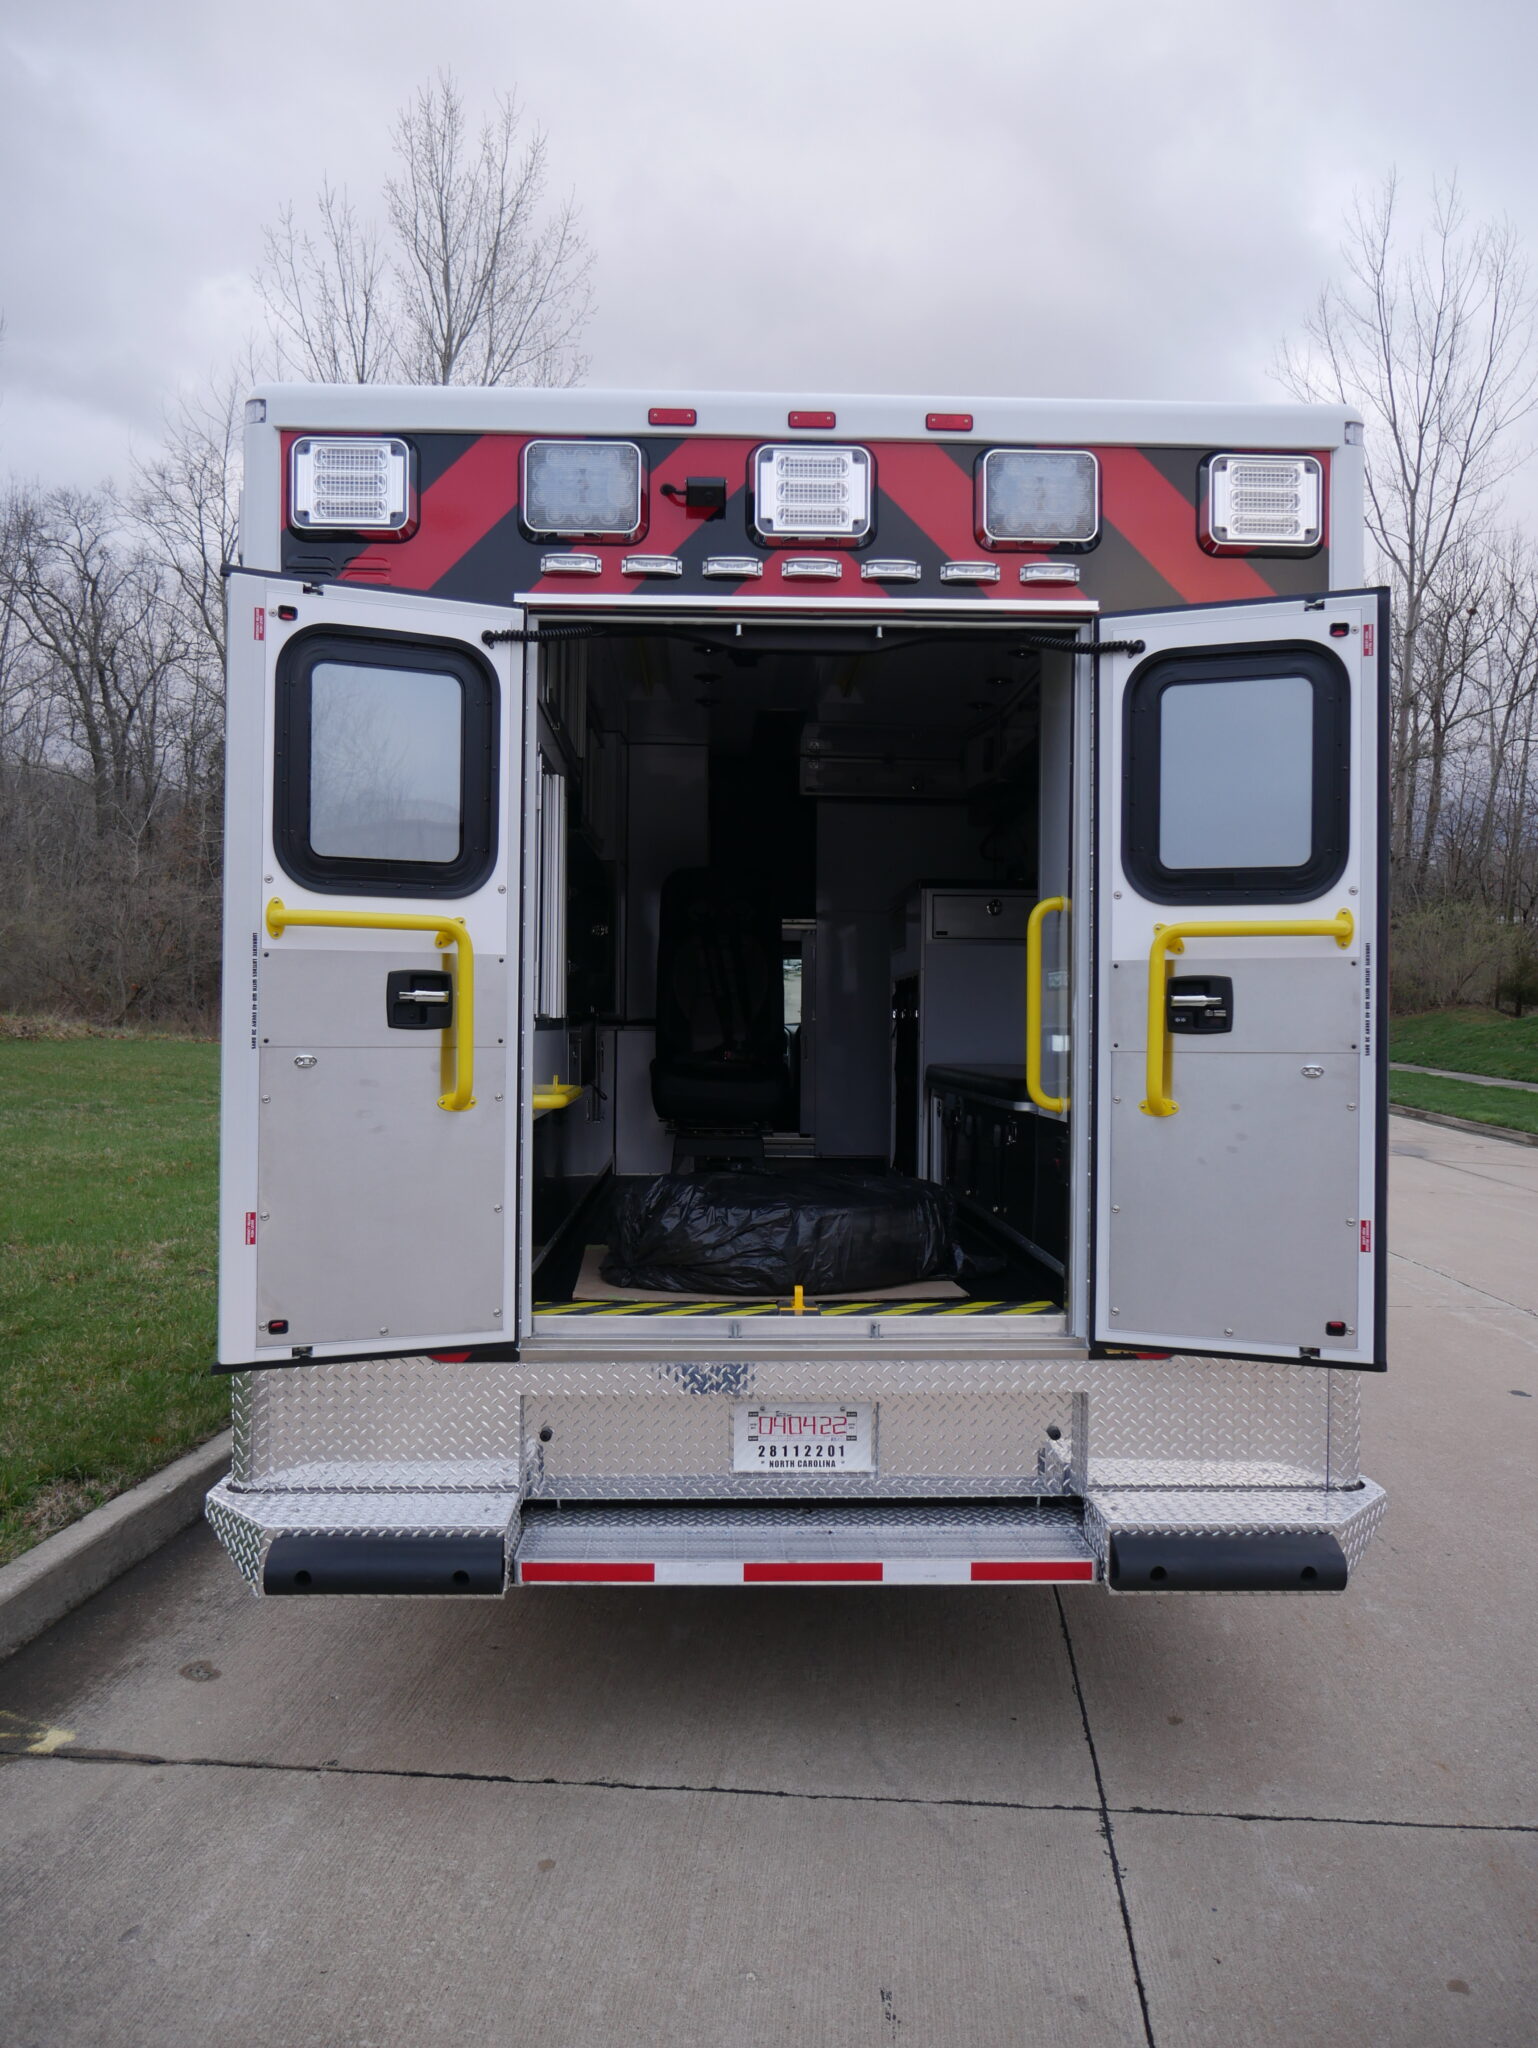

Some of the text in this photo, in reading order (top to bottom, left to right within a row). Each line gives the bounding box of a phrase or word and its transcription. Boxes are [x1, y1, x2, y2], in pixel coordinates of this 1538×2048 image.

[758, 1445, 845, 1457] 28112201
[769, 1459, 836, 1468] NORTH CAROLINA
